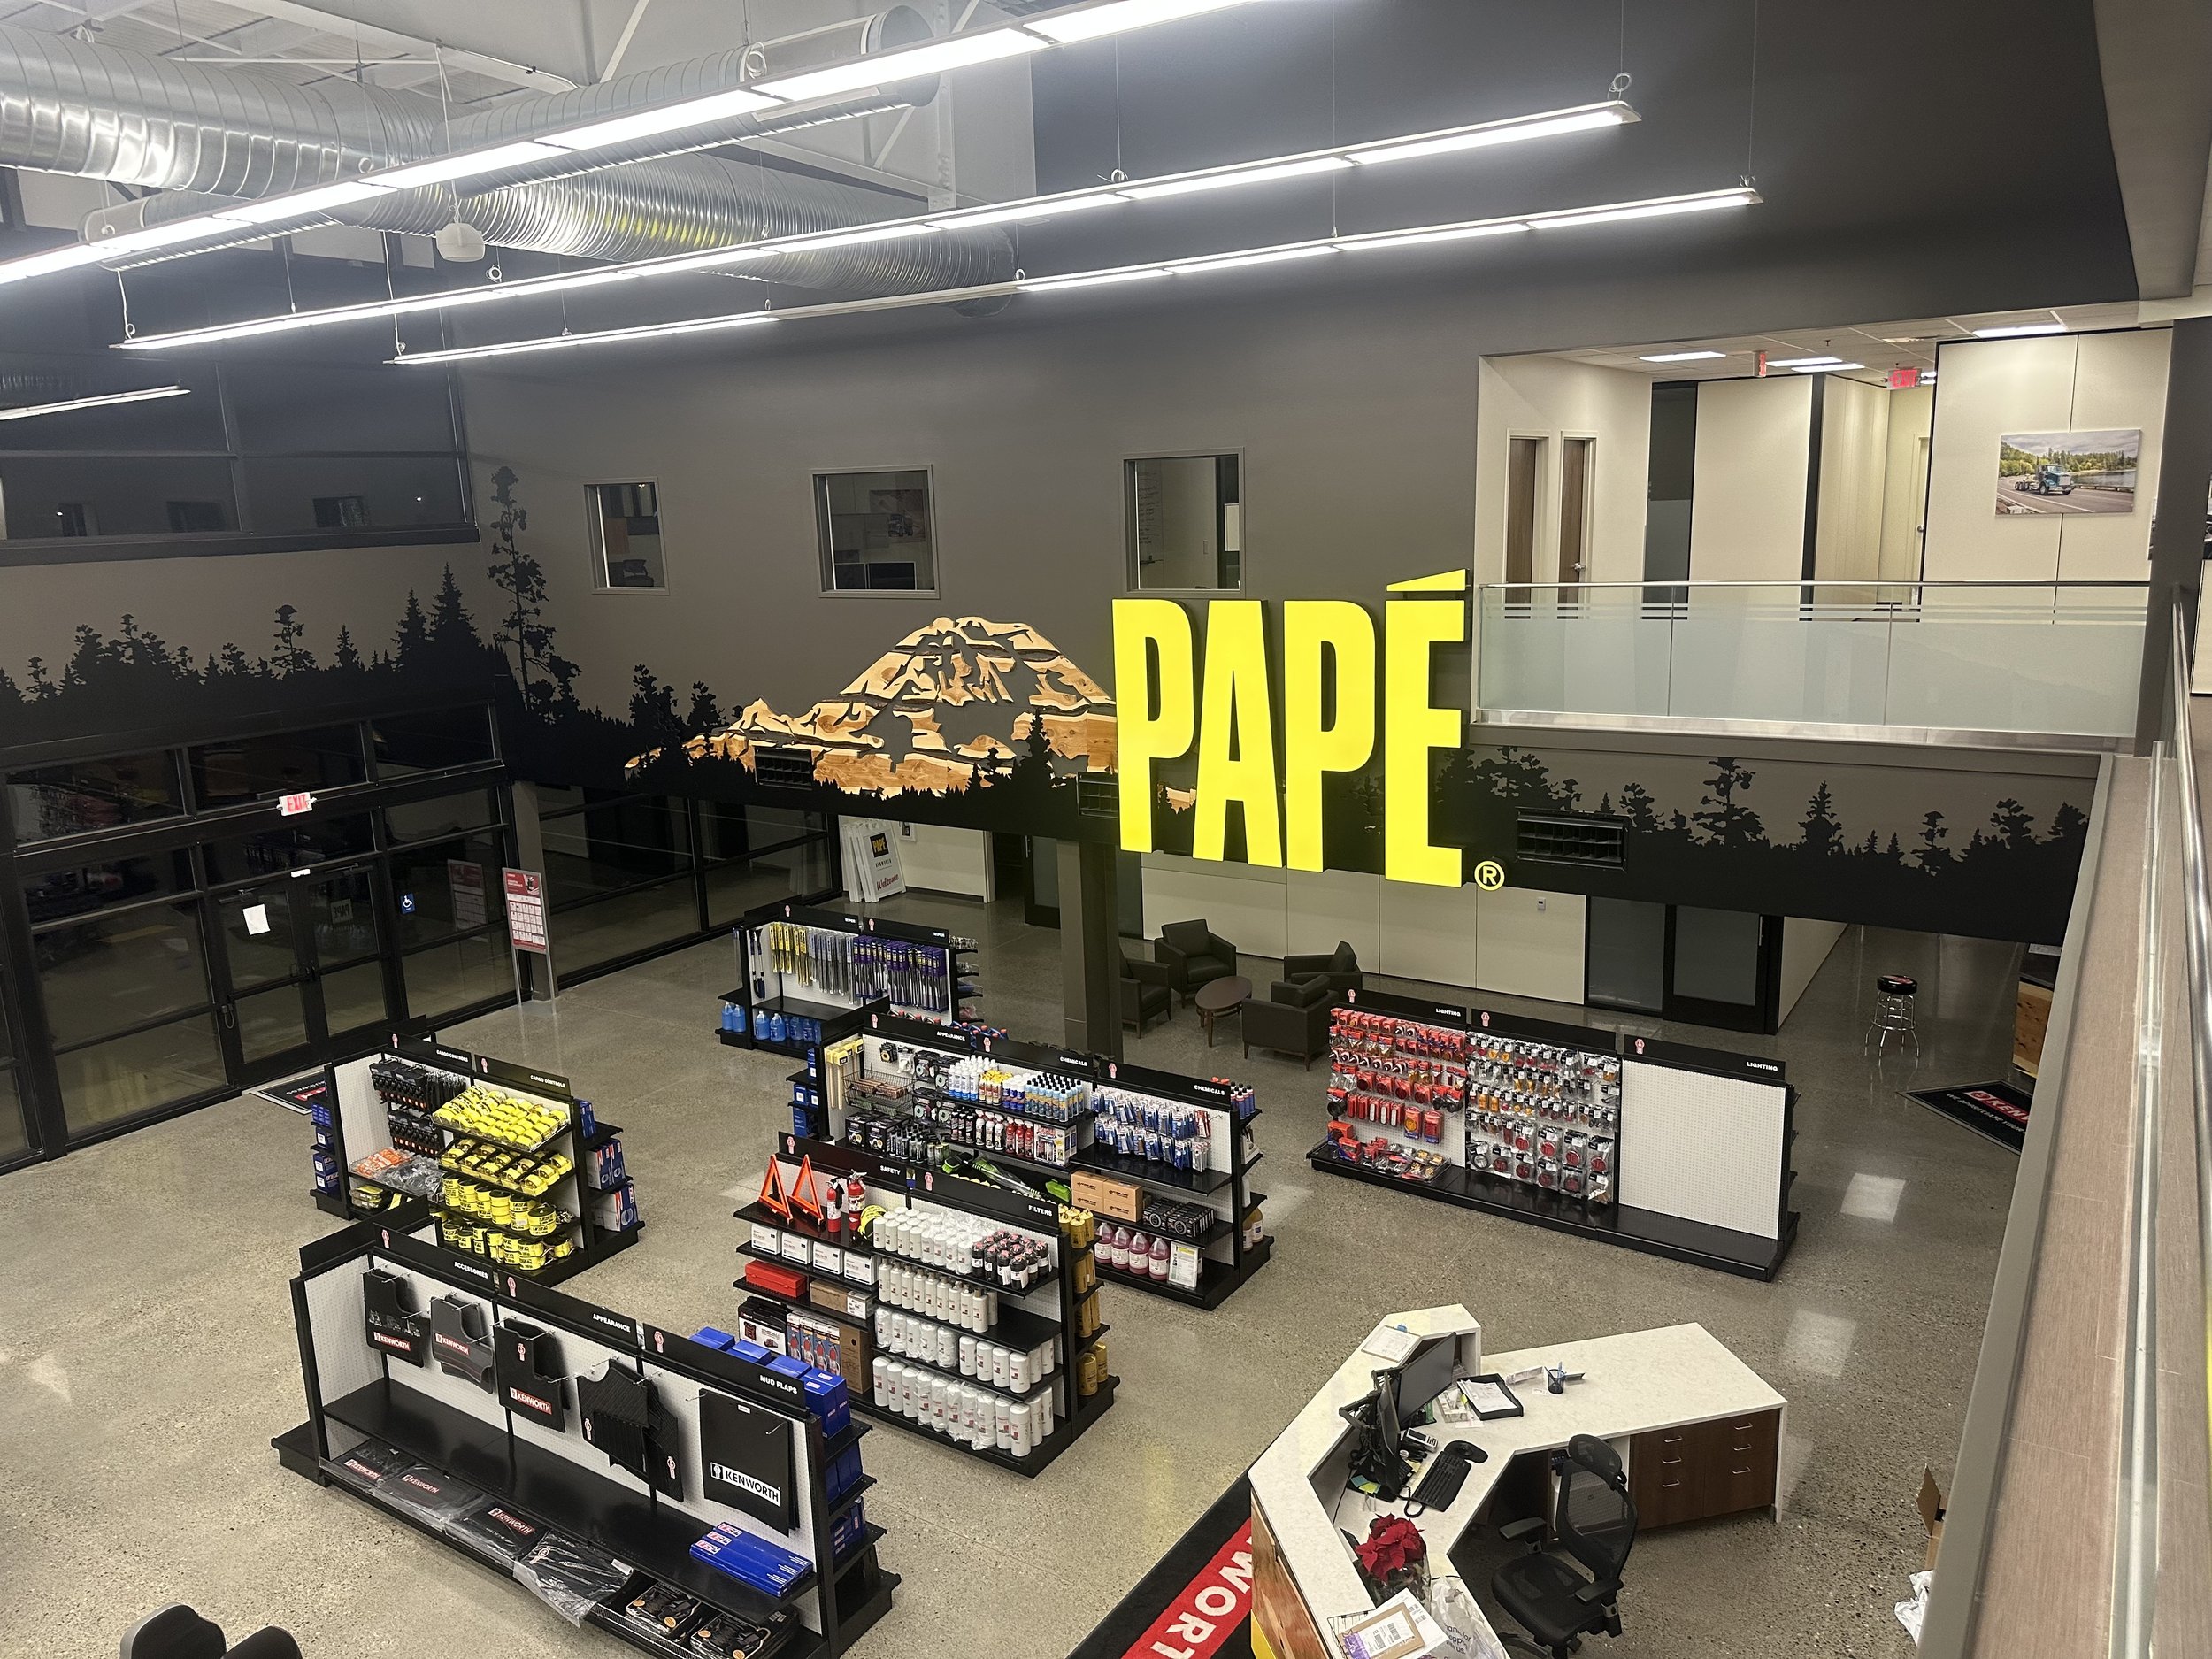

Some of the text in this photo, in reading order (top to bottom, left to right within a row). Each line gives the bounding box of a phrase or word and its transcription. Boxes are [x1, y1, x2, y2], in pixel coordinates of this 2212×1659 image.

[1112, 569, 1466, 887] PAPÉ
[287, 794, 307, 812] EXIT
[876, 874, 899, 891] Welcome
[1435, 1008, 1461, 1017] LIGHTING
[936, 1031, 965, 1041] APPEARANCE
[449, 1052, 469, 1063] CONTROLS
[1059, 1056, 1088, 1067] CHEMICALS
[1746, 1061, 1778, 1071] LIGHTING
[530, 1074, 566, 1088] CARGO CONTROLS
[1194, 1085, 1225, 1096] CHEMICALS
[879, 1164, 901, 1176] SAFETY
[1028, 1204, 1053, 1217] FILTERS
[454, 1261, 488, 1279] ACCESSORIES
[592, 1313, 631, 1333] APPEARANCE
[380, 1333, 410, 1350] KENWORTH
[442, 1337, 469, 1356] KENWORTH
[759, 1374, 775, 1386] MUD
[776, 1380, 798, 1394] FLAPS
[518, 1391, 551, 1414] KENWORTH
[353, 1462, 380, 1480] KENWORTH
[410, 1477, 440, 1494] KENWORTH
[726, 1470, 780, 1502] KENWORTH
[498, 1512, 534, 1535] KENWORTH
[1150, 1536, 1252, 1659] WORT
